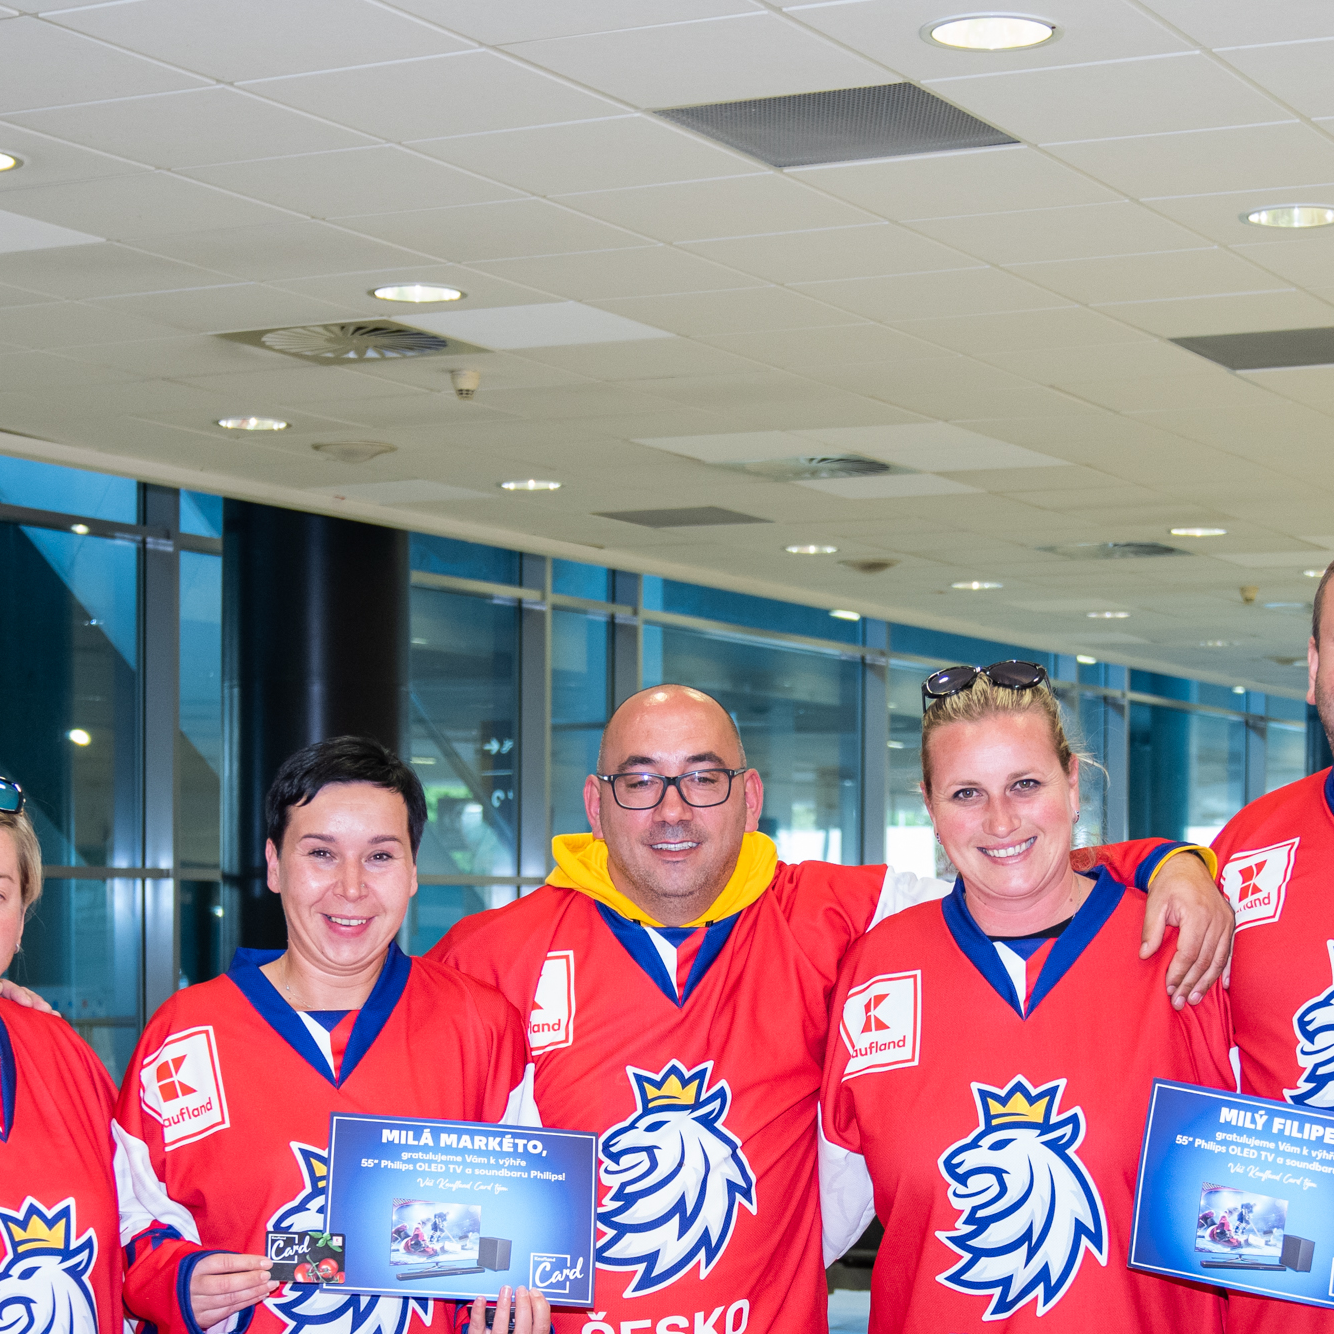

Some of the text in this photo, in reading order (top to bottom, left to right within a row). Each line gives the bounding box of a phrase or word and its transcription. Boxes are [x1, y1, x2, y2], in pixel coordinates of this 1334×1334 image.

[851, 1034, 906, 1059] aufland
[162, 1096, 213, 1128] aufland
[1219, 1107, 1268, 1130] MILÝ
[382, 1128, 548, 1157] MILÁ MARKÉTO,
[1194, 1138, 1226, 1154] Philips
[1228, 1146, 1258, 1158] OLED
[1260, 1151, 1275, 1162] TV
[1216, 1132, 1276, 1149] gratulujeme
[1278, 1141, 1300, 1154] Vám
[1302, 1146, 1309, 1156] k
[380, 1160, 414, 1171] Philips
[416, 1162, 446, 1172] OLED
[448, 1164, 462, 1174] TV
[474, 1168, 528, 1178] soundbaru
[530, 1170, 566, 1182] Philips!
[401, 1152, 526, 1167] gratulujeme Vám k výhře
[474, 1182, 494, 1190] Card
[1282, 1174, 1304, 1186] Card
[271, 1235, 312, 1260] Card
[534, 1256, 584, 1287] Card
